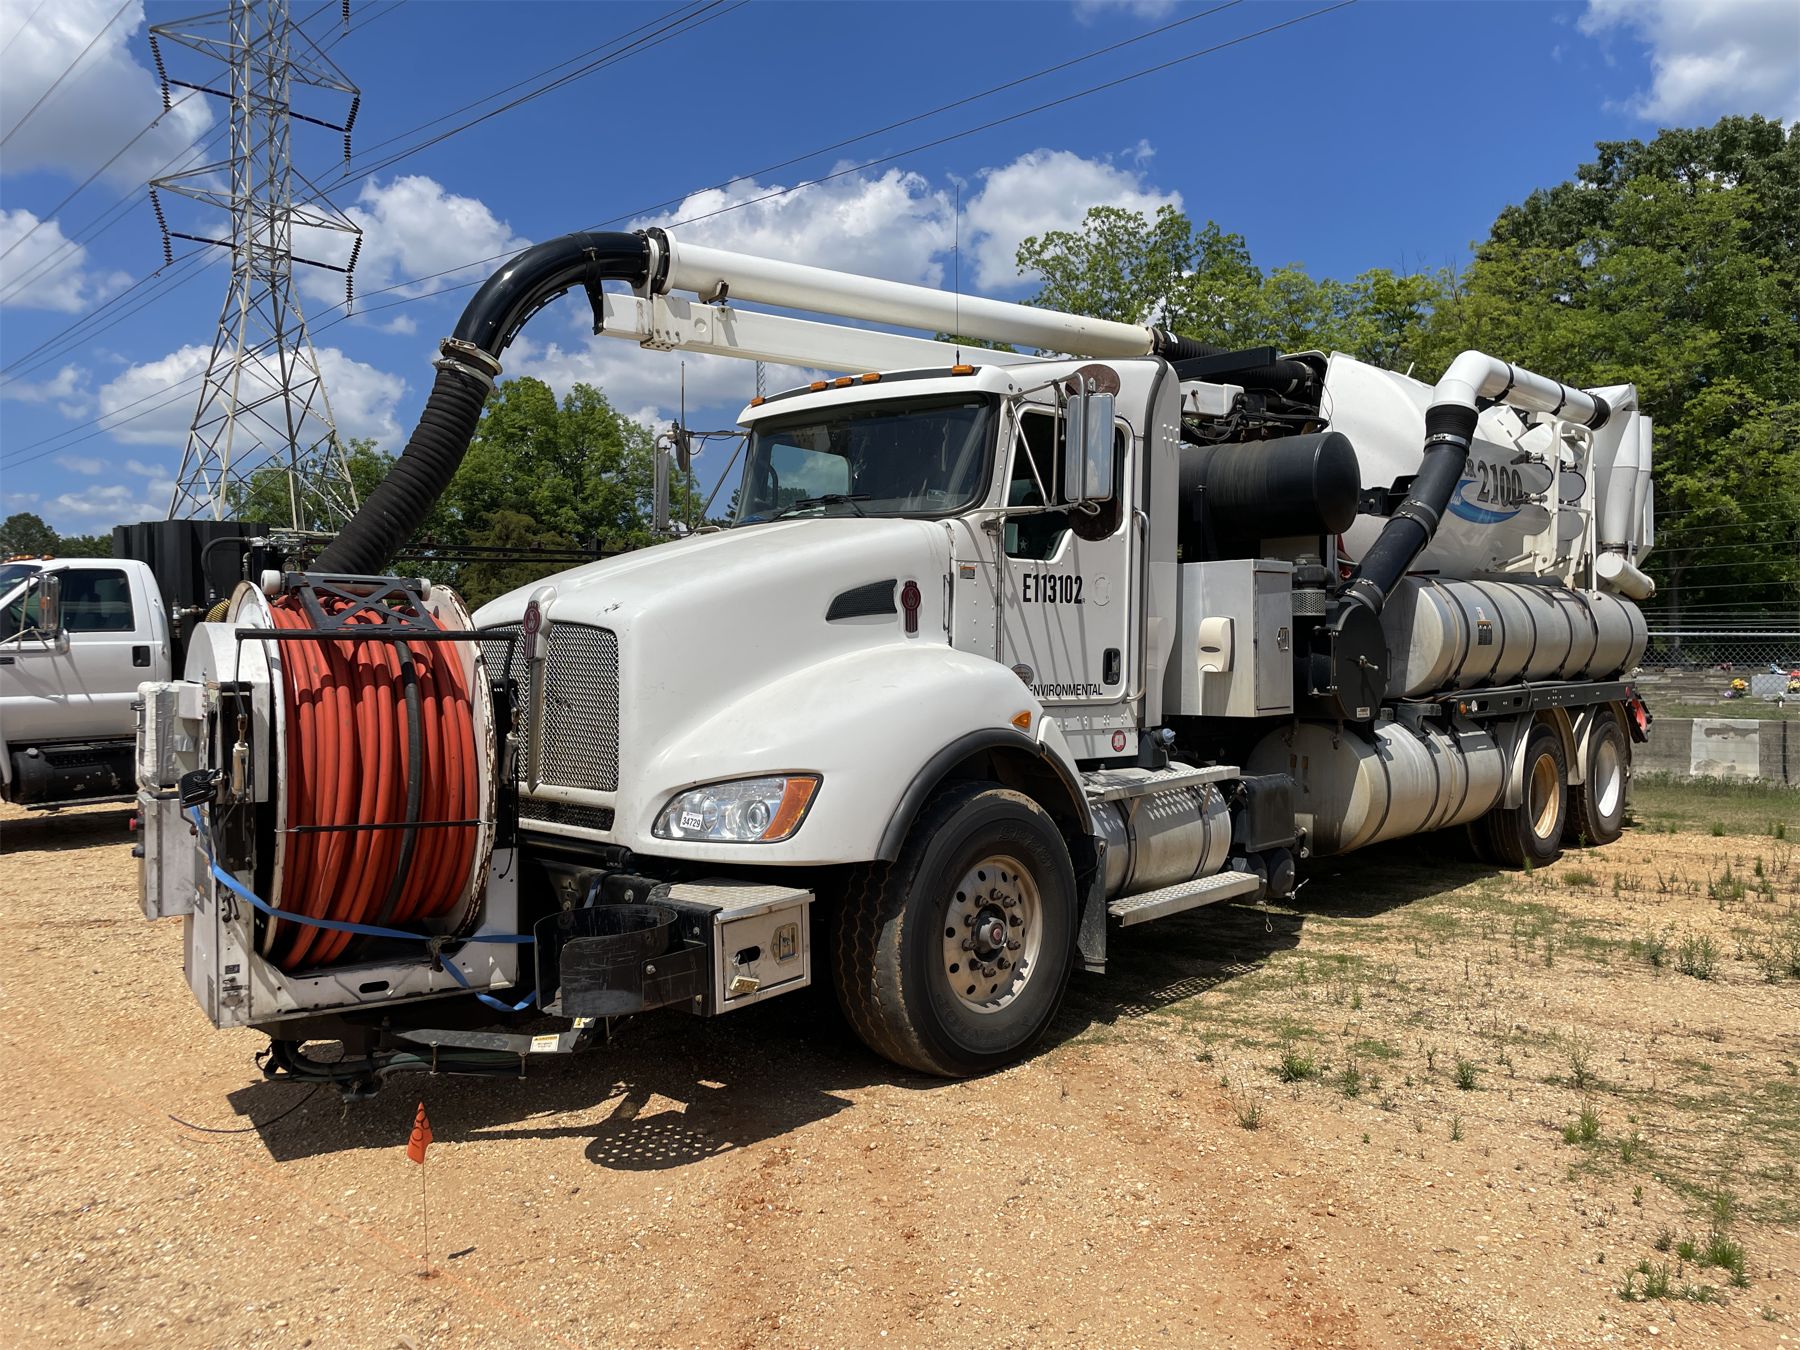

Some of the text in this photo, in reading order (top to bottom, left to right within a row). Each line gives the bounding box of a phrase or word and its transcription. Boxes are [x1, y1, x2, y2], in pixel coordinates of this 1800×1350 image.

[1477, 459, 1523, 509] 2100
[1023, 573, 1083, 604] E113102
[682, 816, 701, 828] 34729
